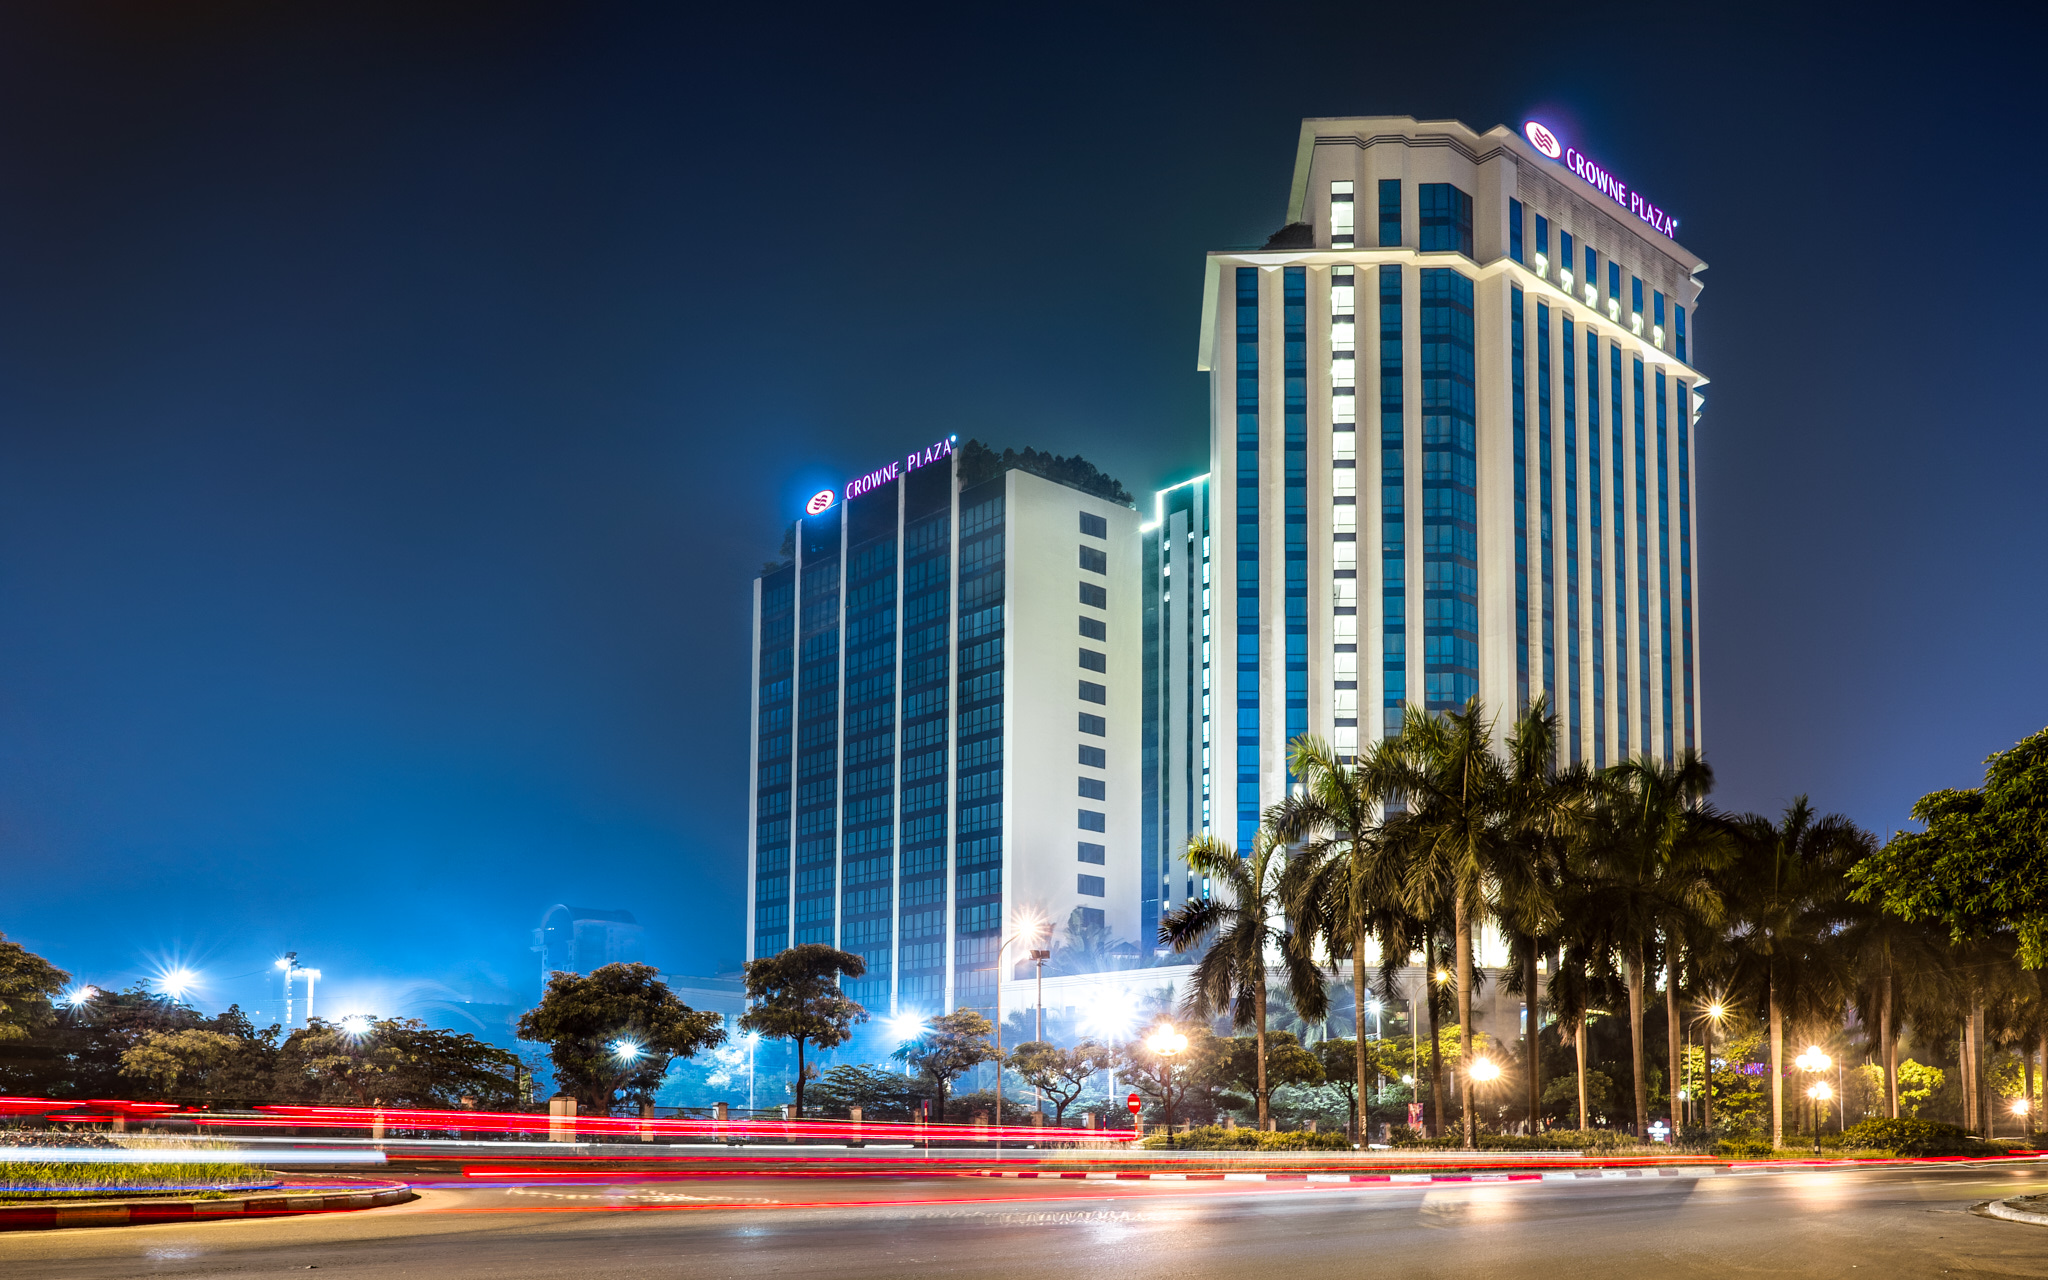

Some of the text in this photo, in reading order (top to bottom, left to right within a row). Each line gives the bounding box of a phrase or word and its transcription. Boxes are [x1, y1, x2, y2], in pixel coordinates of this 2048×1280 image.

[1566, 147, 1674, 239] CROWNE PLAZA
[845, 438, 952, 500] CROWNE PLAZA
